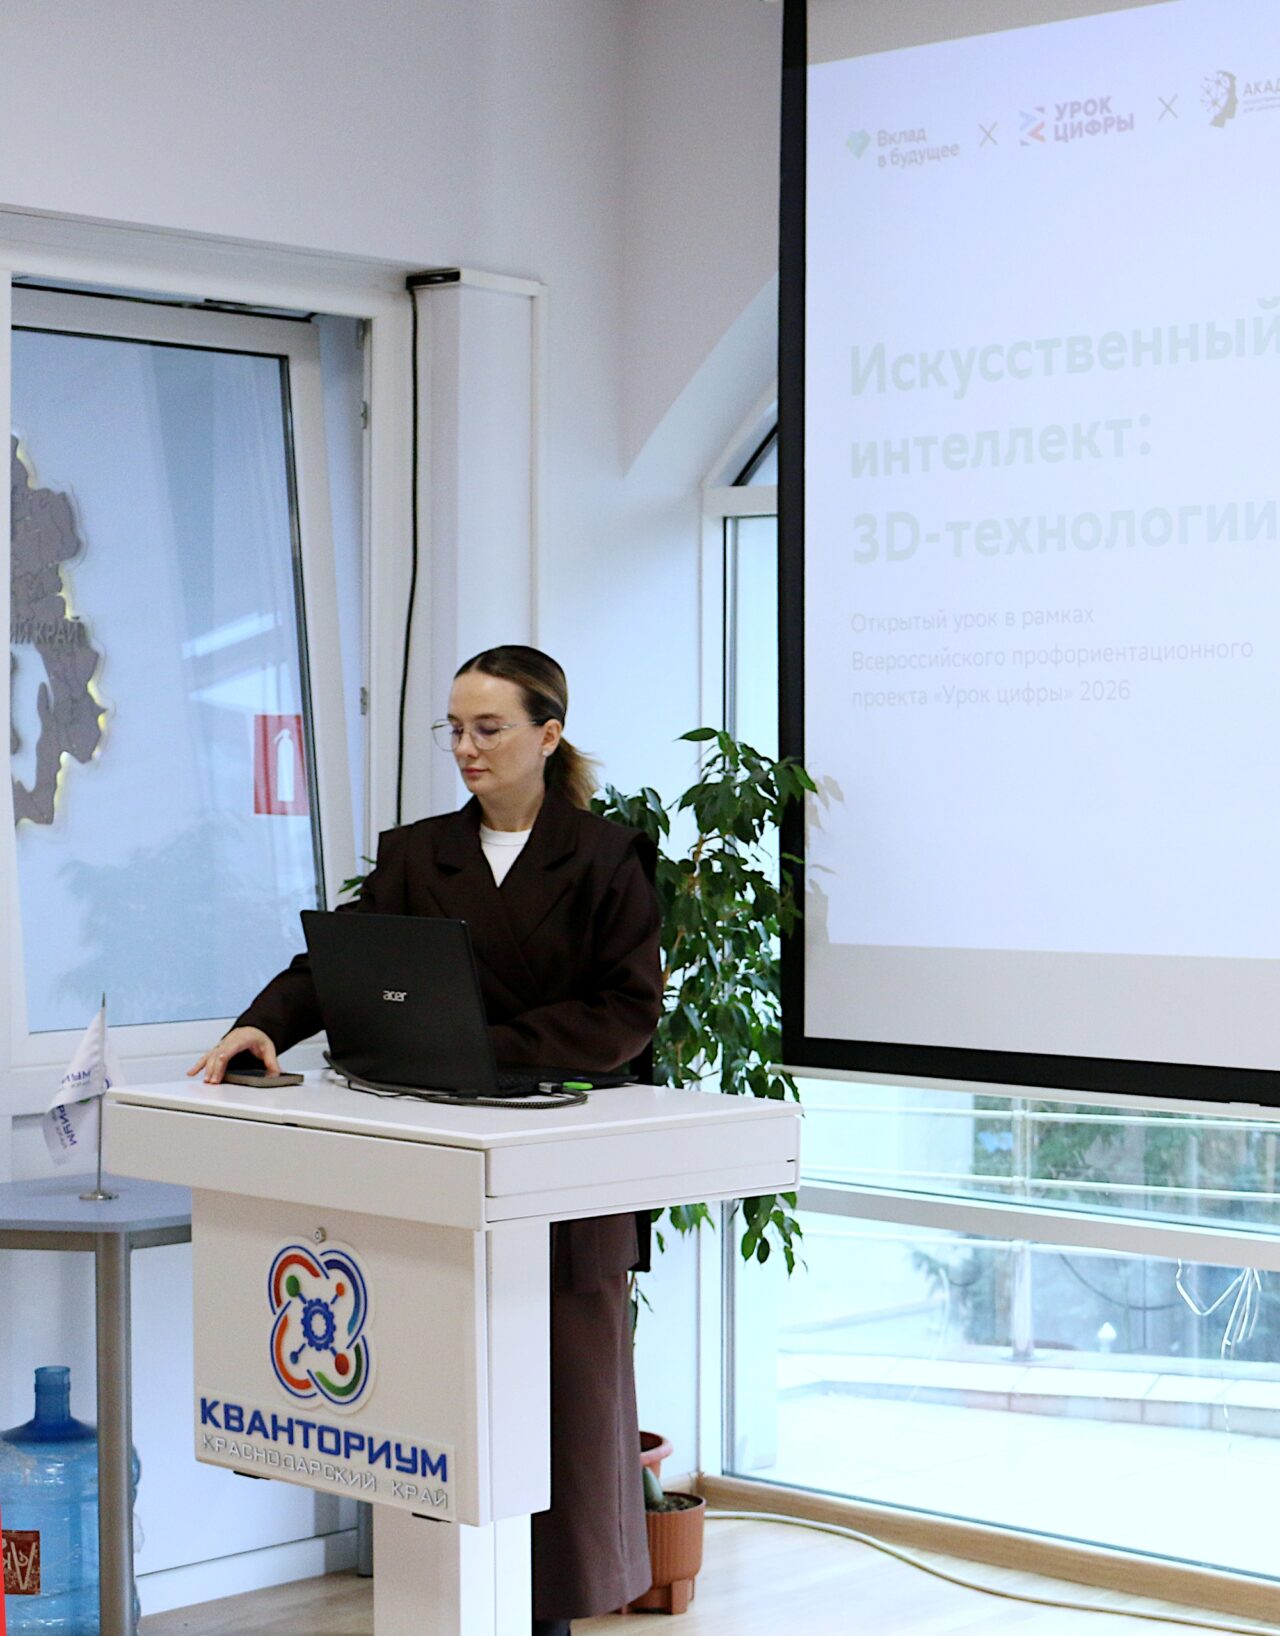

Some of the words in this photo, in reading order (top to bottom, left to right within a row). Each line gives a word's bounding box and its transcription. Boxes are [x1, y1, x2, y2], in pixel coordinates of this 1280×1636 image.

[1054, 96, 1112, 120] УРОК
[877, 128, 927, 147] Вклад
[1054, 113, 1135, 142] ЦИФРЫ
[877, 154, 886, 168] в
[890, 143, 960, 168] будущее
[850, 413, 1151, 479] интеллект:
[852, 500, 1278, 564] 3D-технологии
[851, 609, 947, 634] Открытый
[952, 613, 998, 633] урок
[1005, 613, 1016, 627] в
[1022, 608, 1095, 629] рамках
[852, 647, 1005, 674] Всероссийского
[1012, 641, 1254, 668] профориентационного
[852, 690, 928, 710] проекта
[934, 685, 991, 705] «Урок
[997, 681, 1073, 705] цифры»
[1079, 680, 1131, 702] 2026
[383, 990, 407, 1002] acer
[200, 1398, 448, 1482] КВАНТОРИУМ
[202, 1434, 378, 1492] КРАСНОДАРСКИЙ
[392, 1480, 448, 1510] КРАЙ
